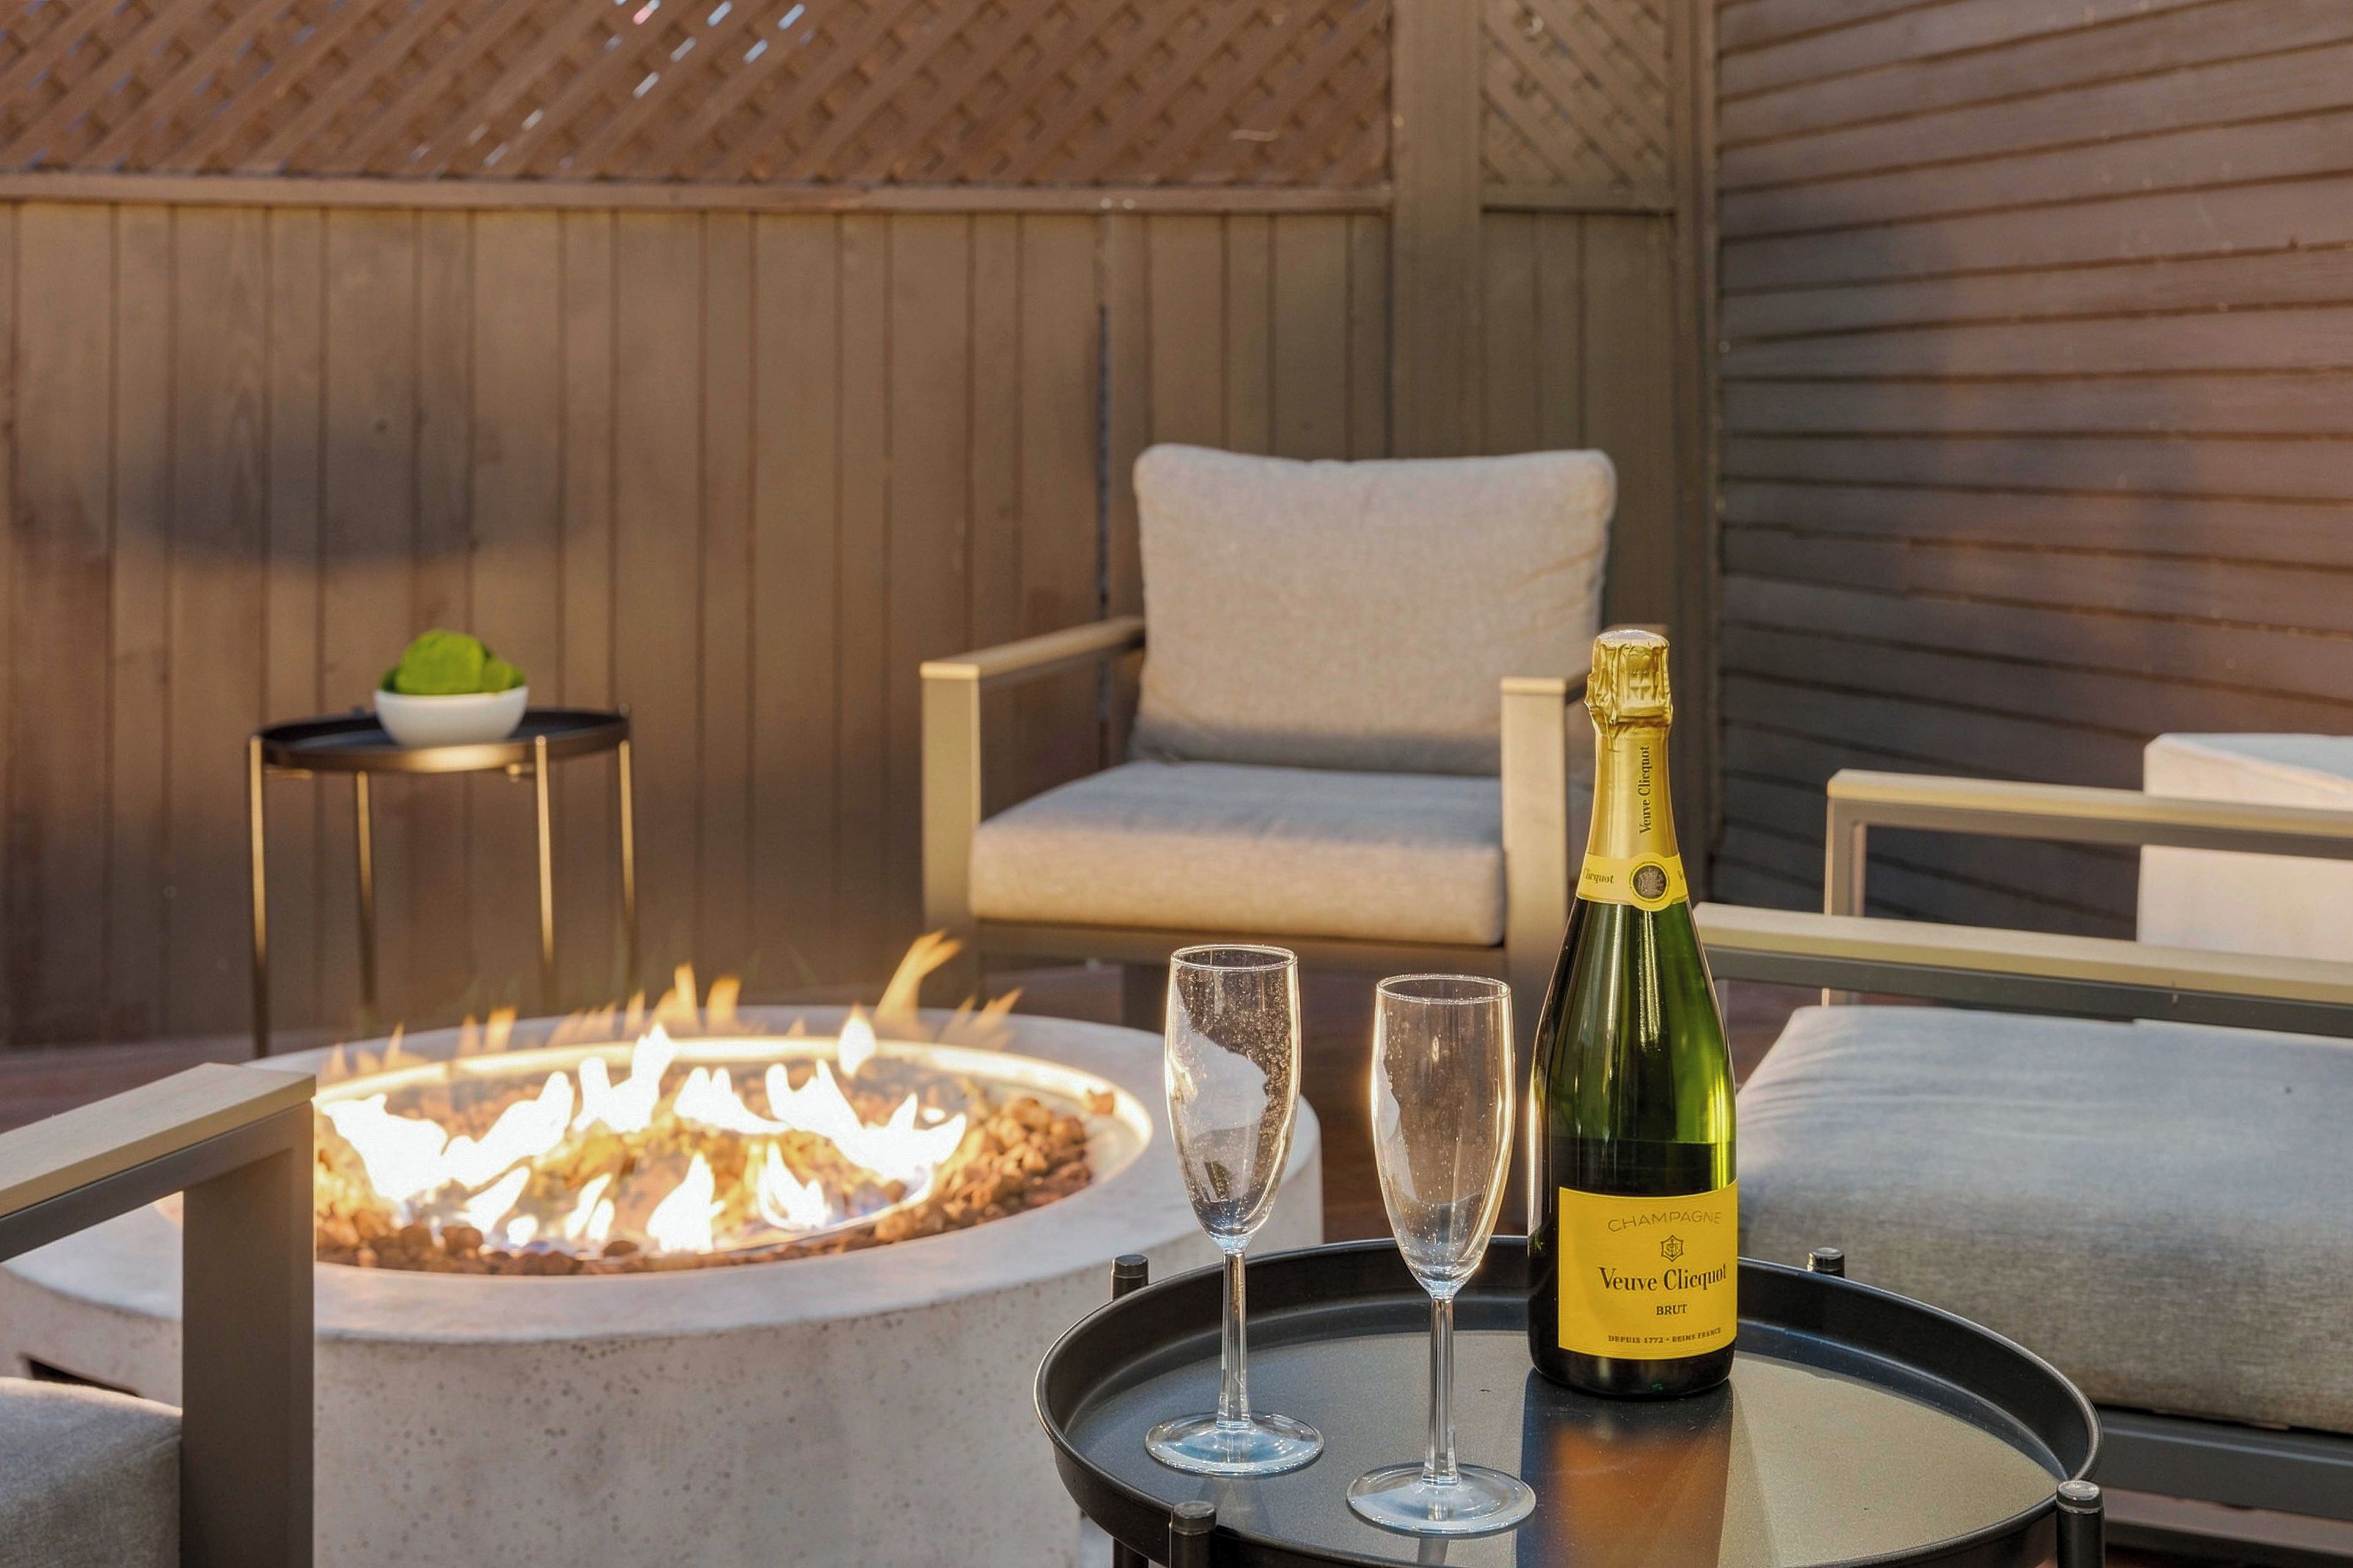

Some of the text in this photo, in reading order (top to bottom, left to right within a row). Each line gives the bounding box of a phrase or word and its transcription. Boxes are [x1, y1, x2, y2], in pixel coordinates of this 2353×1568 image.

[1637, 746, 1653, 835] Veuve Clicquot
[1607, 1210, 1722, 1232] CHAMPAGNE
[1598, 1263, 1726, 1291] Veuve Clicquot
[1656, 1304, 1688, 1316] BRUT
[1608, 1335, 1640, 1344] DEPUIS
[1672, 1333, 1696, 1343] REIMS
[1697, 1327, 1721, 1339] FRANCE
